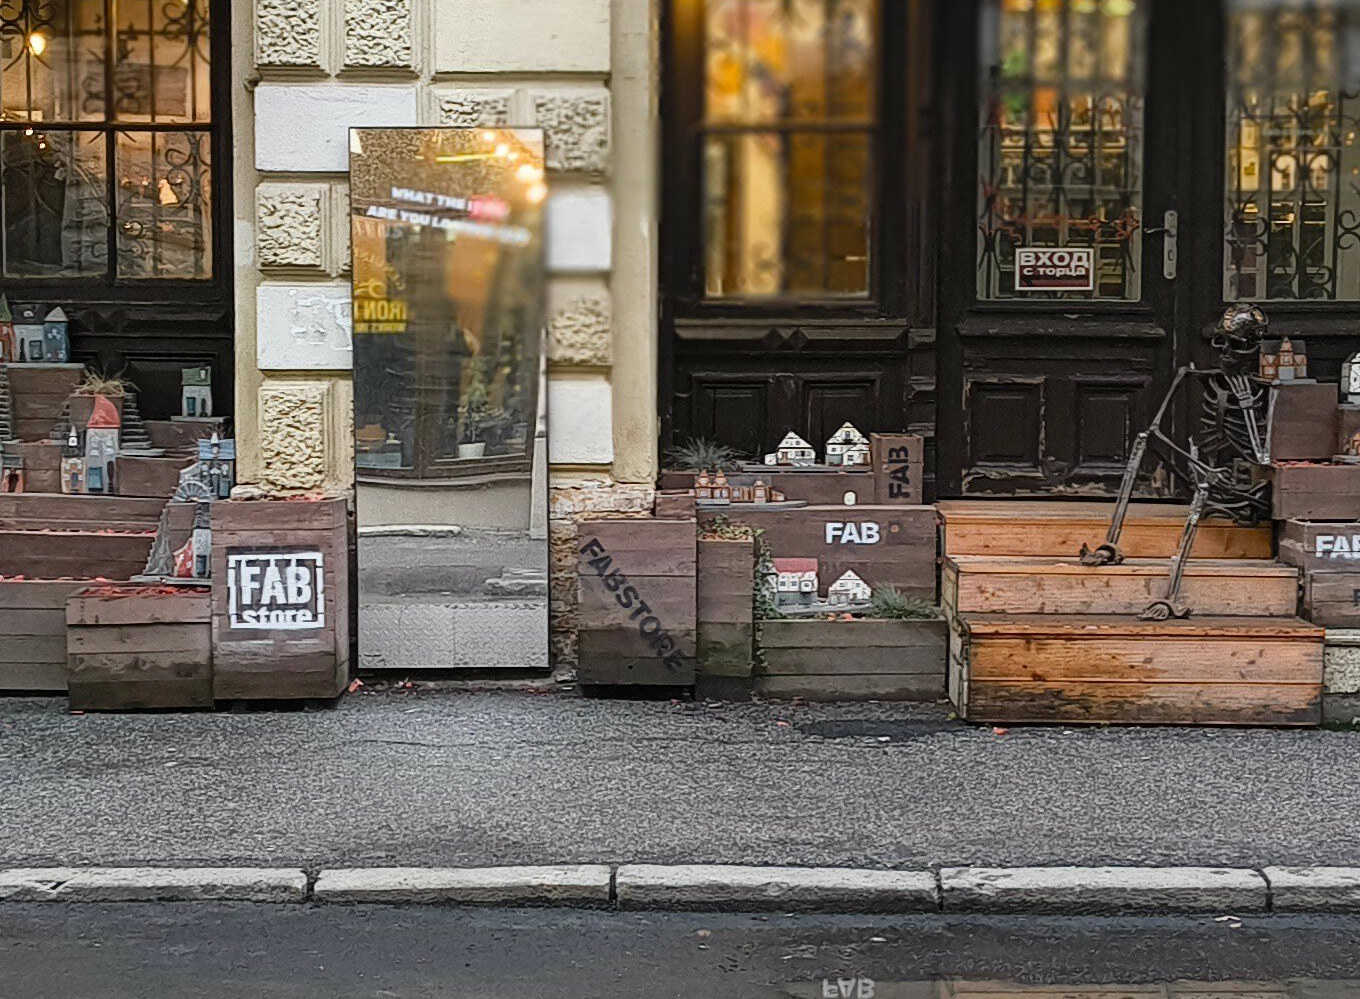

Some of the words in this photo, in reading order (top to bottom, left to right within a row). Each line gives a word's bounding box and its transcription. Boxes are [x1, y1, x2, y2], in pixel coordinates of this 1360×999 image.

[1020, 251, 1090, 268] ВХОД
[1037, 266, 1086, 277] торца
[888, 445, 911, 499] FAB
[825, 522, 881, 544] FAB
[241, 565, 312, 605] FAB
[242, 606, 313, 624] store
